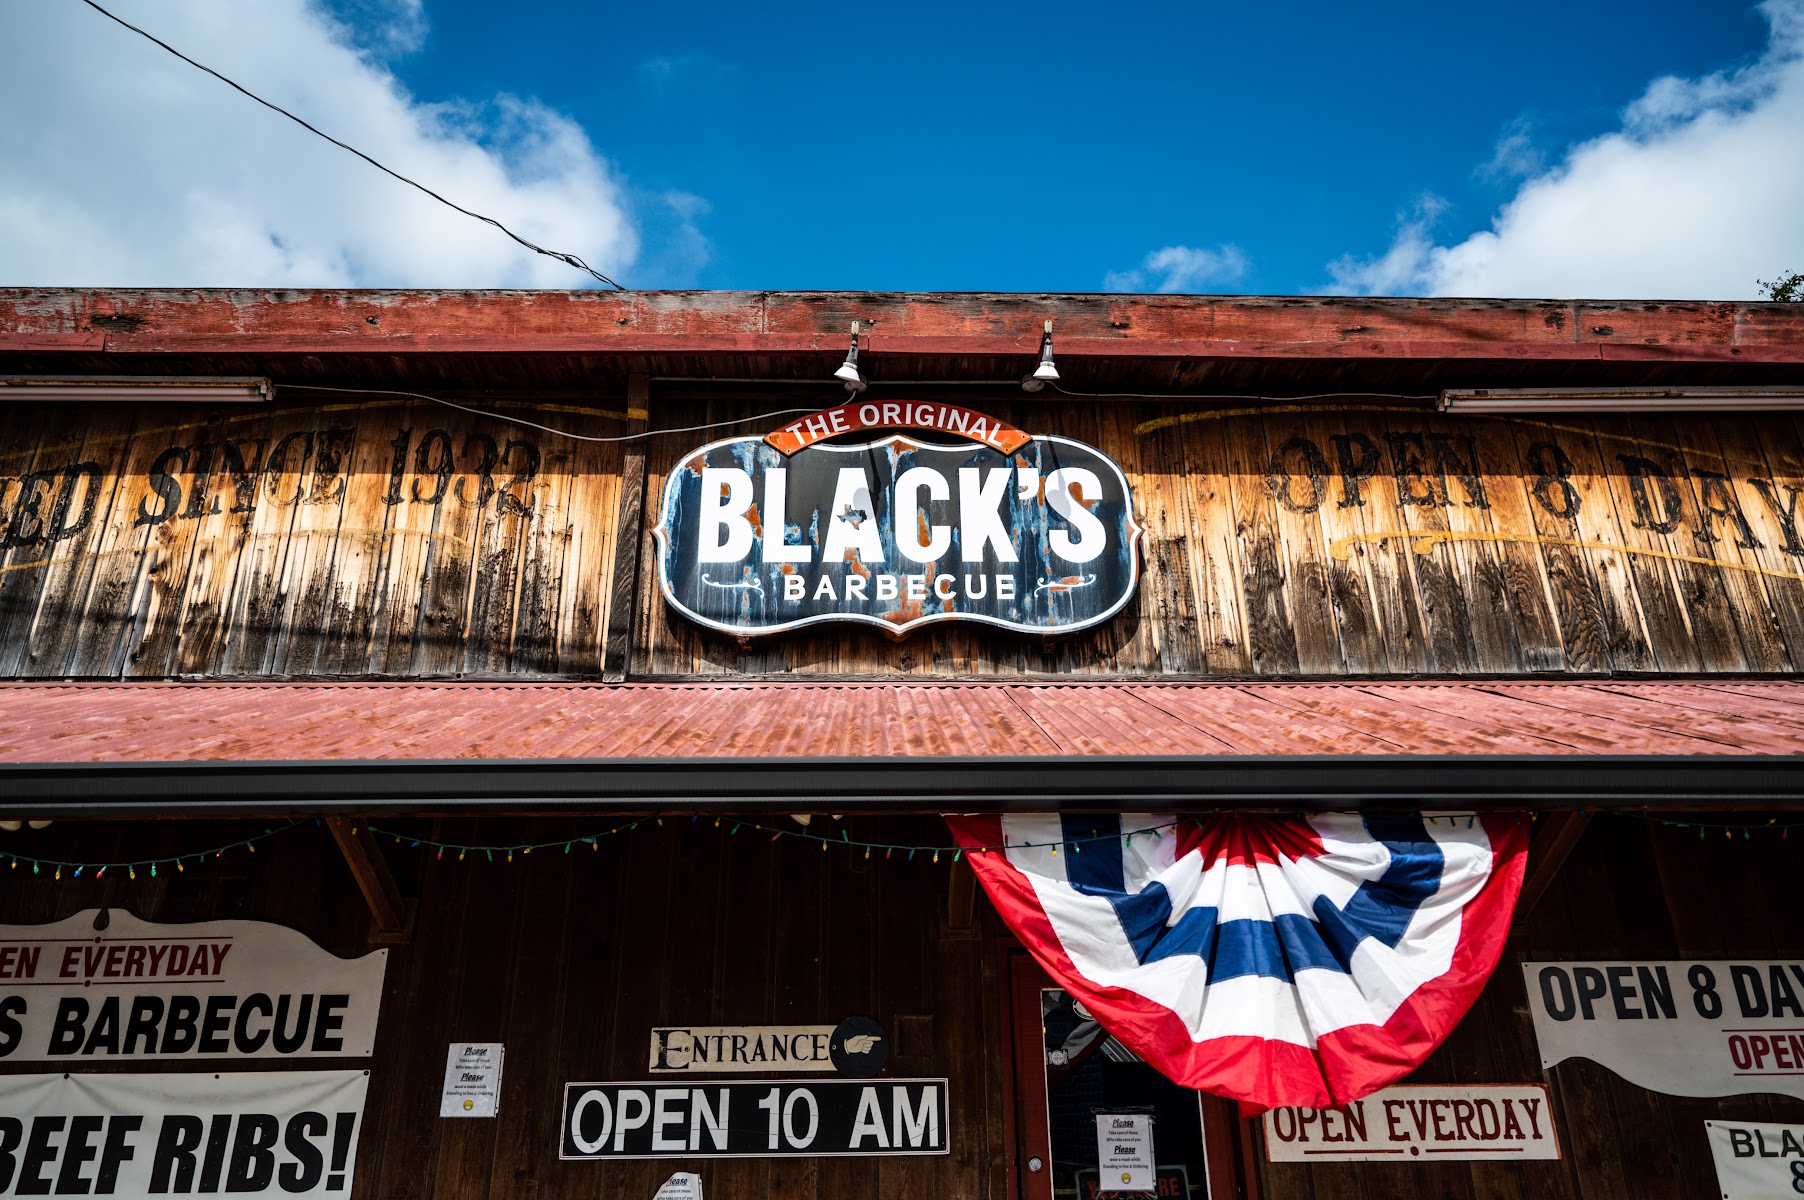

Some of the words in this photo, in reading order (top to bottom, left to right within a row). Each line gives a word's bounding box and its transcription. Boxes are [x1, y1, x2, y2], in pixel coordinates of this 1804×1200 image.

[785, 409, 851, 446] THE
[859, 403, 1004, 447] ORIGINAL
[0, 461, 103, 549] ED
[134, 428, 355, 526] SINCE
[381, 428, 541, 518] 1932
[1268, 430, 1491, 514] OPEN
[1524, 440, 1582, 519] 8
[697, 466, 1107, 564] BLACK'S
[784, 573, 1015, 600] BARBECUE
[59, 943, 232, 977] EVERYDAY
[1539, 966, 1678, 1021] OPEN
[1687, 965, 1723, 1020] 8
[47, 992, 350, 1055] BARBECUE
[464, 1047, 488, 1056] Please
[651, 1029, 829, 1070] ENTRANCE
[460, 1073, 484, 1082] Please
[571, 1088, 731, 1154] OPEN
[759, 1087, 819, 1150] 10
[848, 1085, 939, 1149] AM
[1112, 1119, 1134, 1128] Please
[1273, 1101, 1368, 1142] OPEN
[1382, 1098, 1544, 1142] EVERDAY
[148, 1111, 357, 1194] RIBS!
[1114, 1146, 1136, 1154] Please
